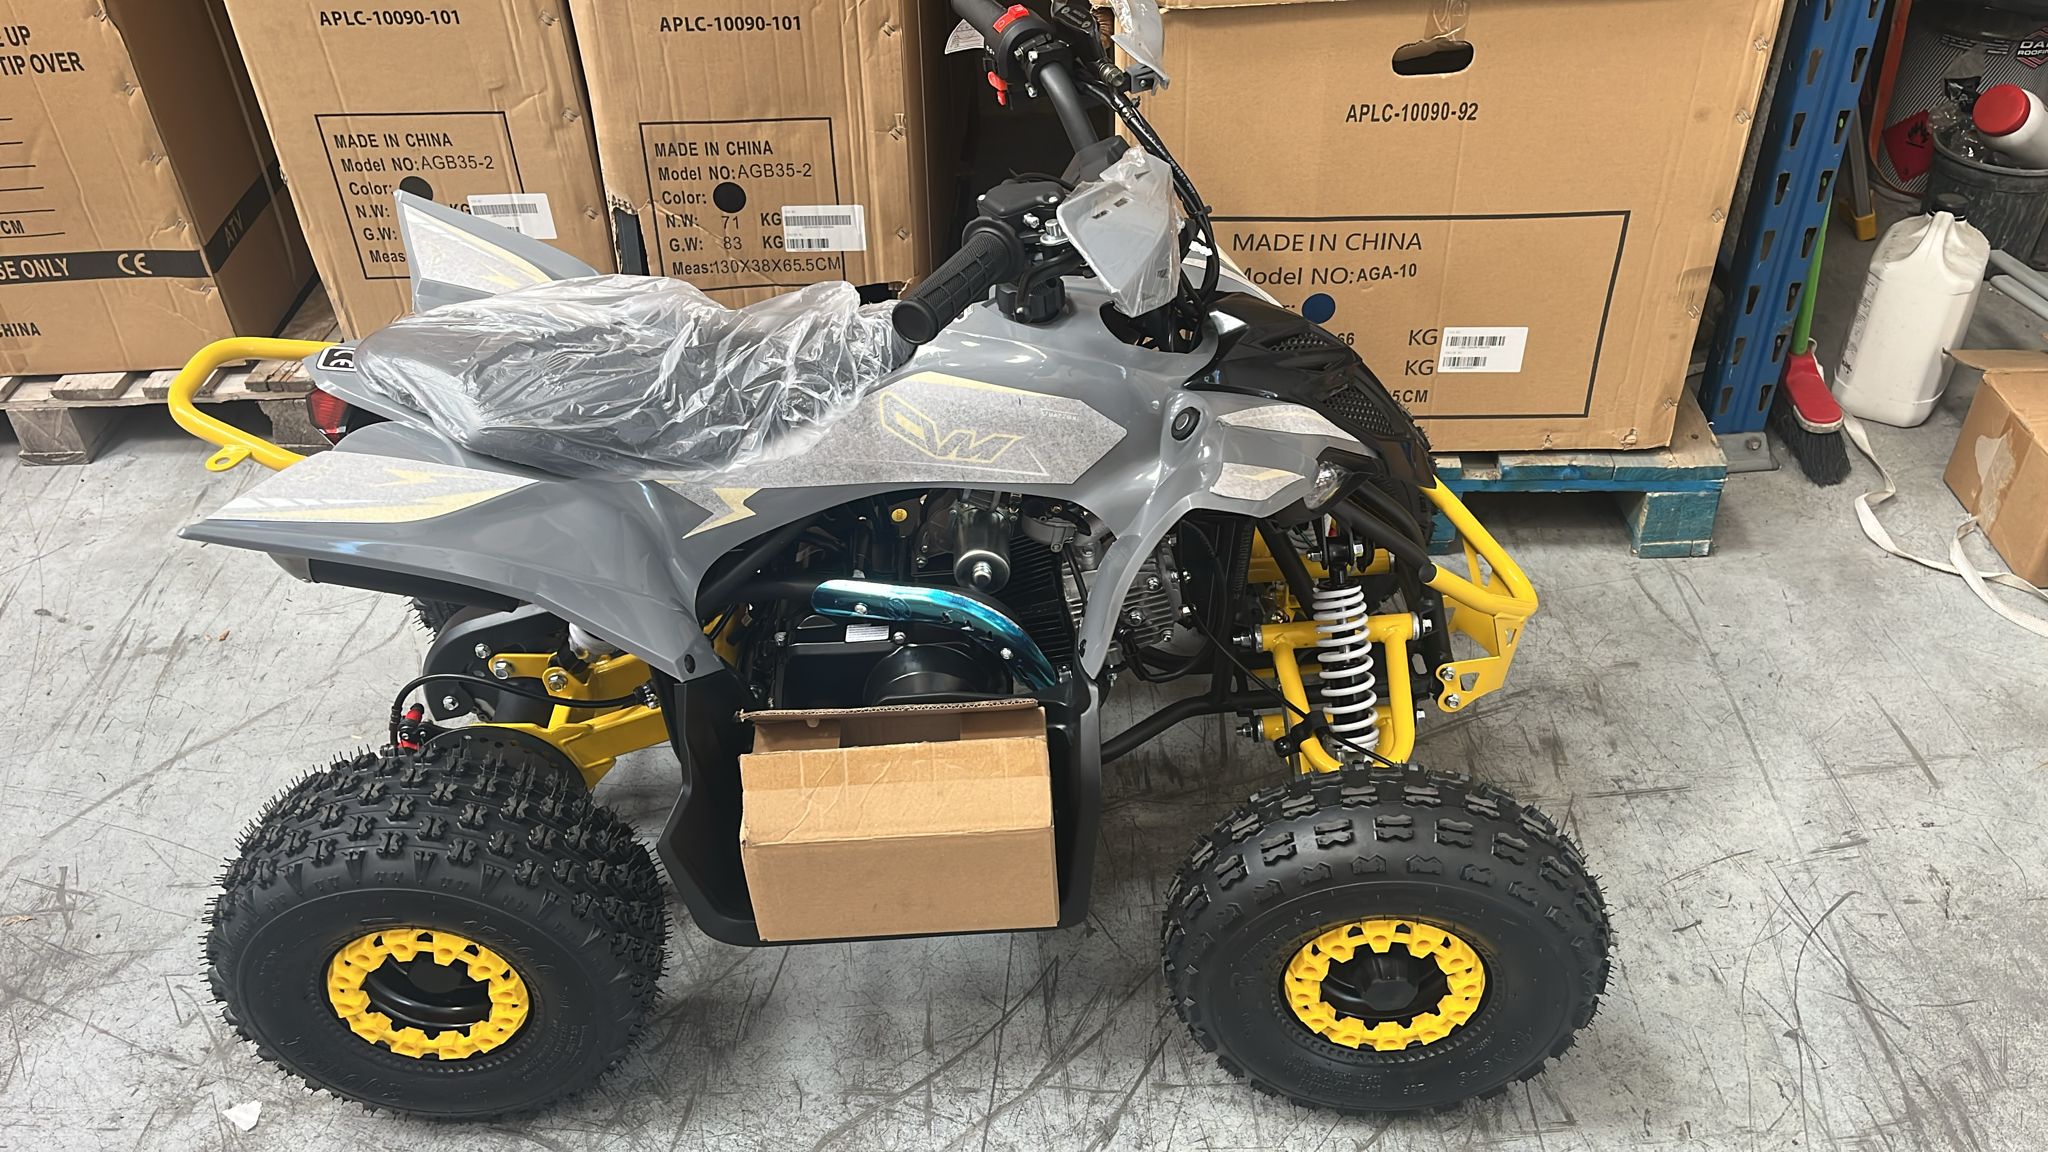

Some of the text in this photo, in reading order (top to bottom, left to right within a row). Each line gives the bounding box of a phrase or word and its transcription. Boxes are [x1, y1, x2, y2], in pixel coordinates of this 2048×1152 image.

[319, 10, 461, 26] APLC-10090-101
[659, 16, 801, 32] APLC-10090-101
[4, 25, 31, 47] UP
[2019, 41, 2048, 49] DA
[0, 51, 85, 76] TIP OVER
[1345, 102, 1479, 122] APLC-10090-92
[333, 132, 453, 149] MADE IN CHINA
[654, 140, 774, 157] MADE IN CHINA
[341, 157, 386, 173] Model
[658, 167, 702, 181] Model
[349, 181, 394, 196] Color:
[662, 191, 707, 206] Color:
[355, 204, 390, 219] N.W:
[666, 212, 782, 229] N.W: 71 KG
[363, 227, 397, 241] G.W:
[1232, 232, 1422, 251] MADE IN CHINA
[669, 235, 784, 252] G.W: 83 KG
[20, 258, 69, 279] ONLY
[0, 322, 41, 338] HINA
[1408, 328, 1438, 346] KG
[1404, 359, 1434, 376] KG
